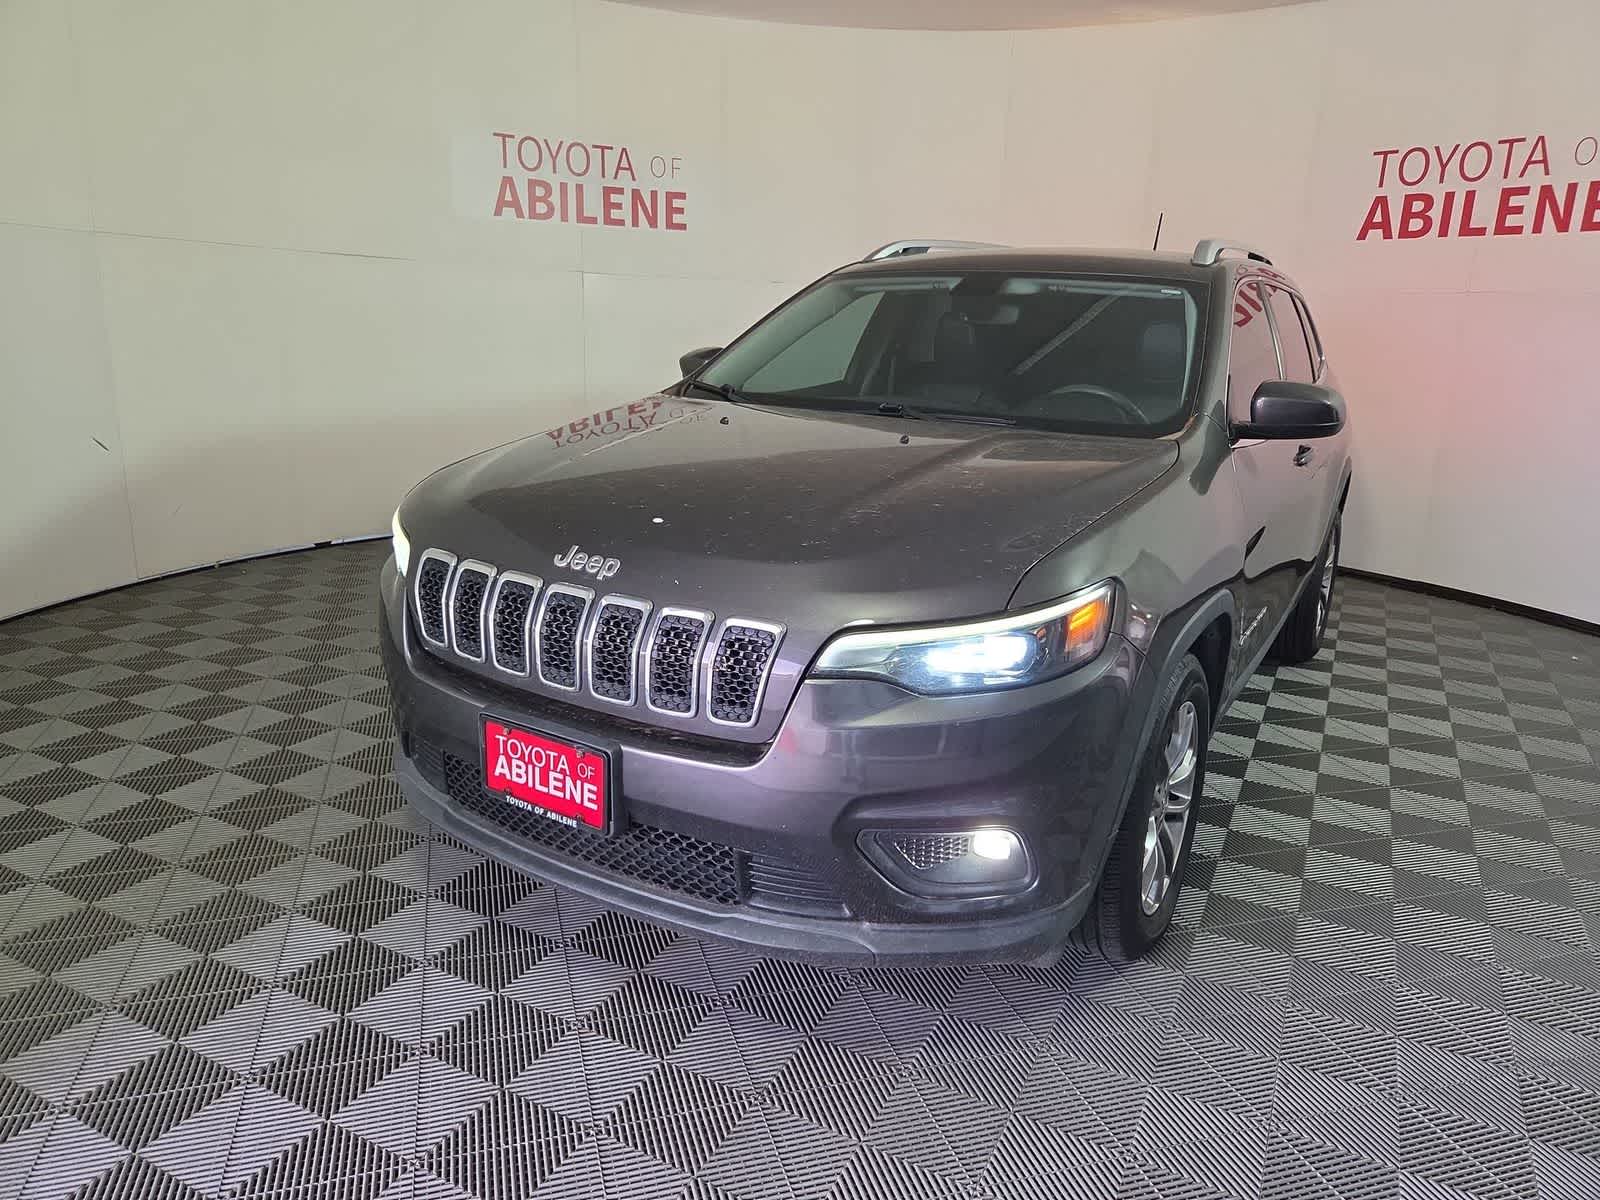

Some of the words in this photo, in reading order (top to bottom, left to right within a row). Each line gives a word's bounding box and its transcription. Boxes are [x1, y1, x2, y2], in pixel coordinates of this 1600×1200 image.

[492, 132, 636, 182] TOYOTA
[649, 155, 682, 179] OF
[1373, 135, 1550, 188] TOYOTA
[493, 175, 688, 231] ABILENE
[553, 544, 621, 580] Jeep
[495, 735, 569, 775] TOYOTA
[577, 762, 596, 780] OF
[494, 755, 599, 811] ABILENE
[505, 795, 532, 812] TOYOTA
[534, 806, 545, 815] OF
[546, 811, 577, 828] ABILENE
